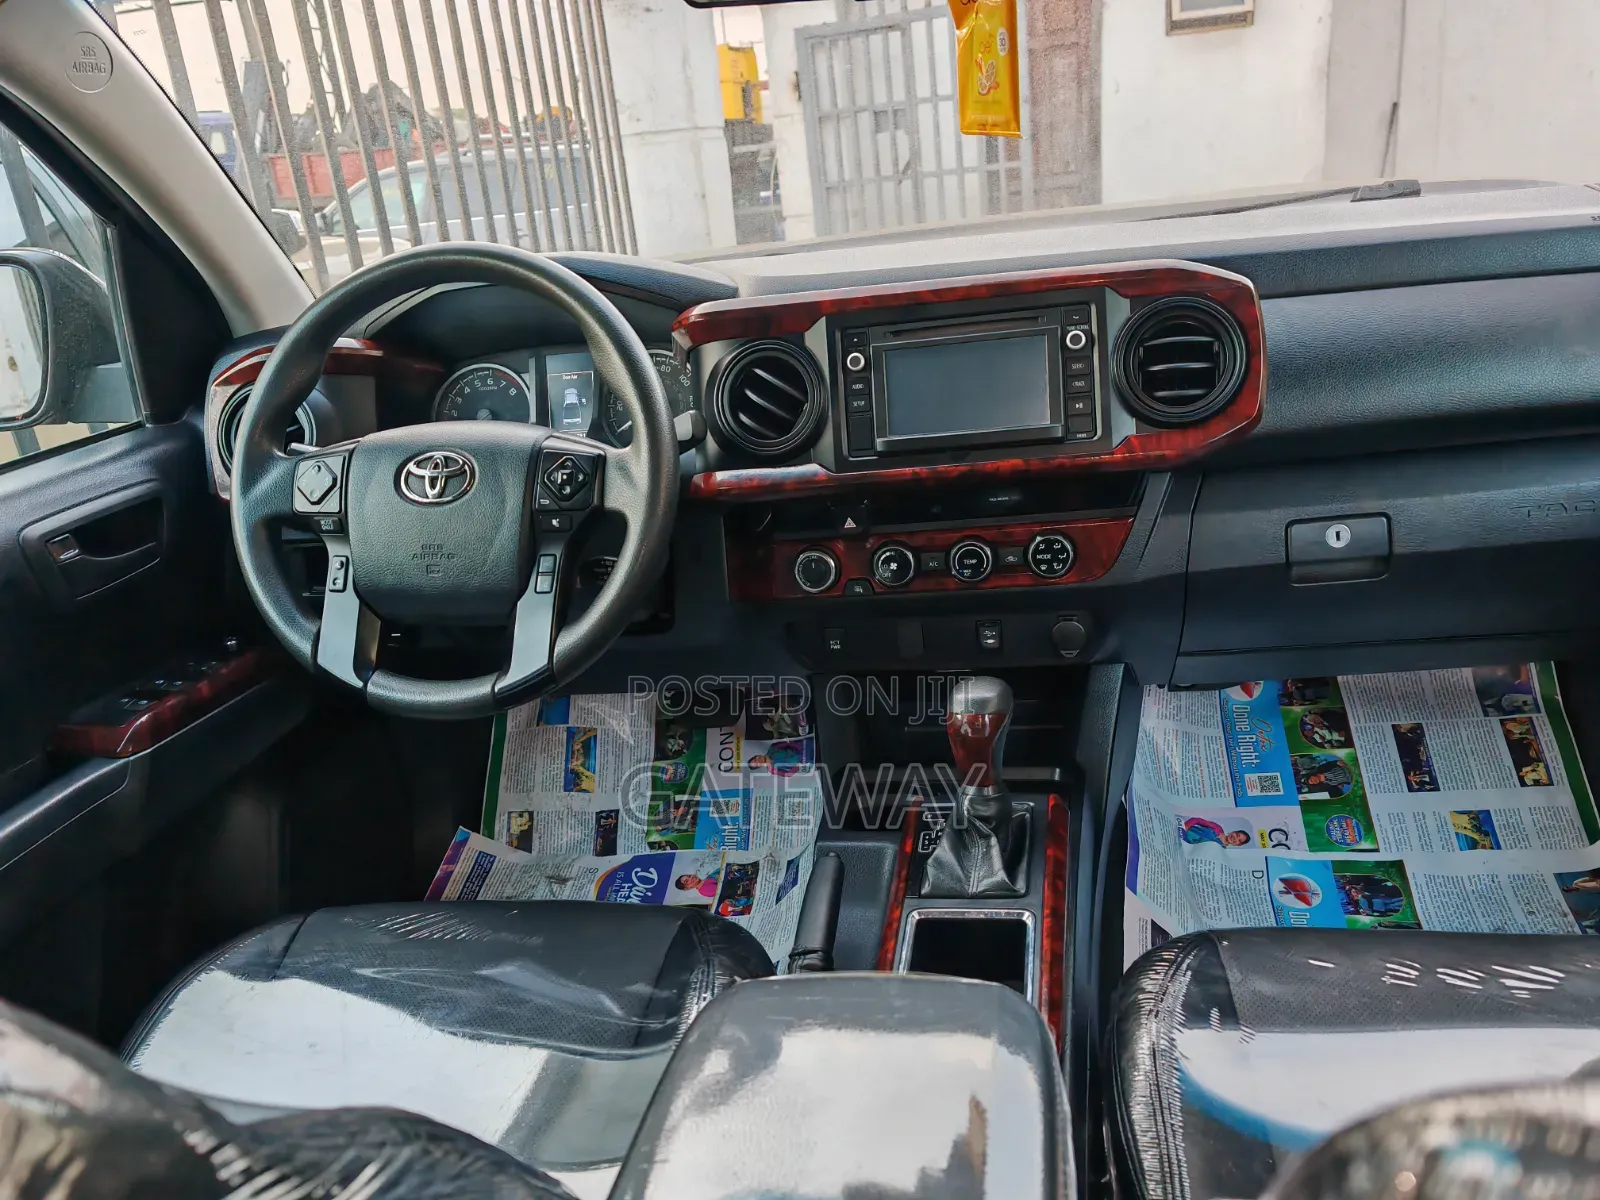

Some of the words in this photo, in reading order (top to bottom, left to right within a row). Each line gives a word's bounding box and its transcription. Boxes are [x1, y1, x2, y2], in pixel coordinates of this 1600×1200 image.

[80, 46, 97, 57] SRS
[72, 61, 106, 74] AIRBAG
[660, 364, 671, 373] 80
[474, 379, 482, 388] 5
[487, 377, 494, 385] 6
[499, 379, 507, 388] 7
[679, 374, 691, 387] 100
[464, 386, 471, 394] 4
[508, 387, 517, 396] 8
[455, 396, 463, 405] 3
[616, 400, 623, 411] 20
[1232, 704, 1253, 732] Done
[1235, 734, 1261, 768] Right:
[1252, 870, 1264, 880] D
[612, 878, 622, 891] ALL
